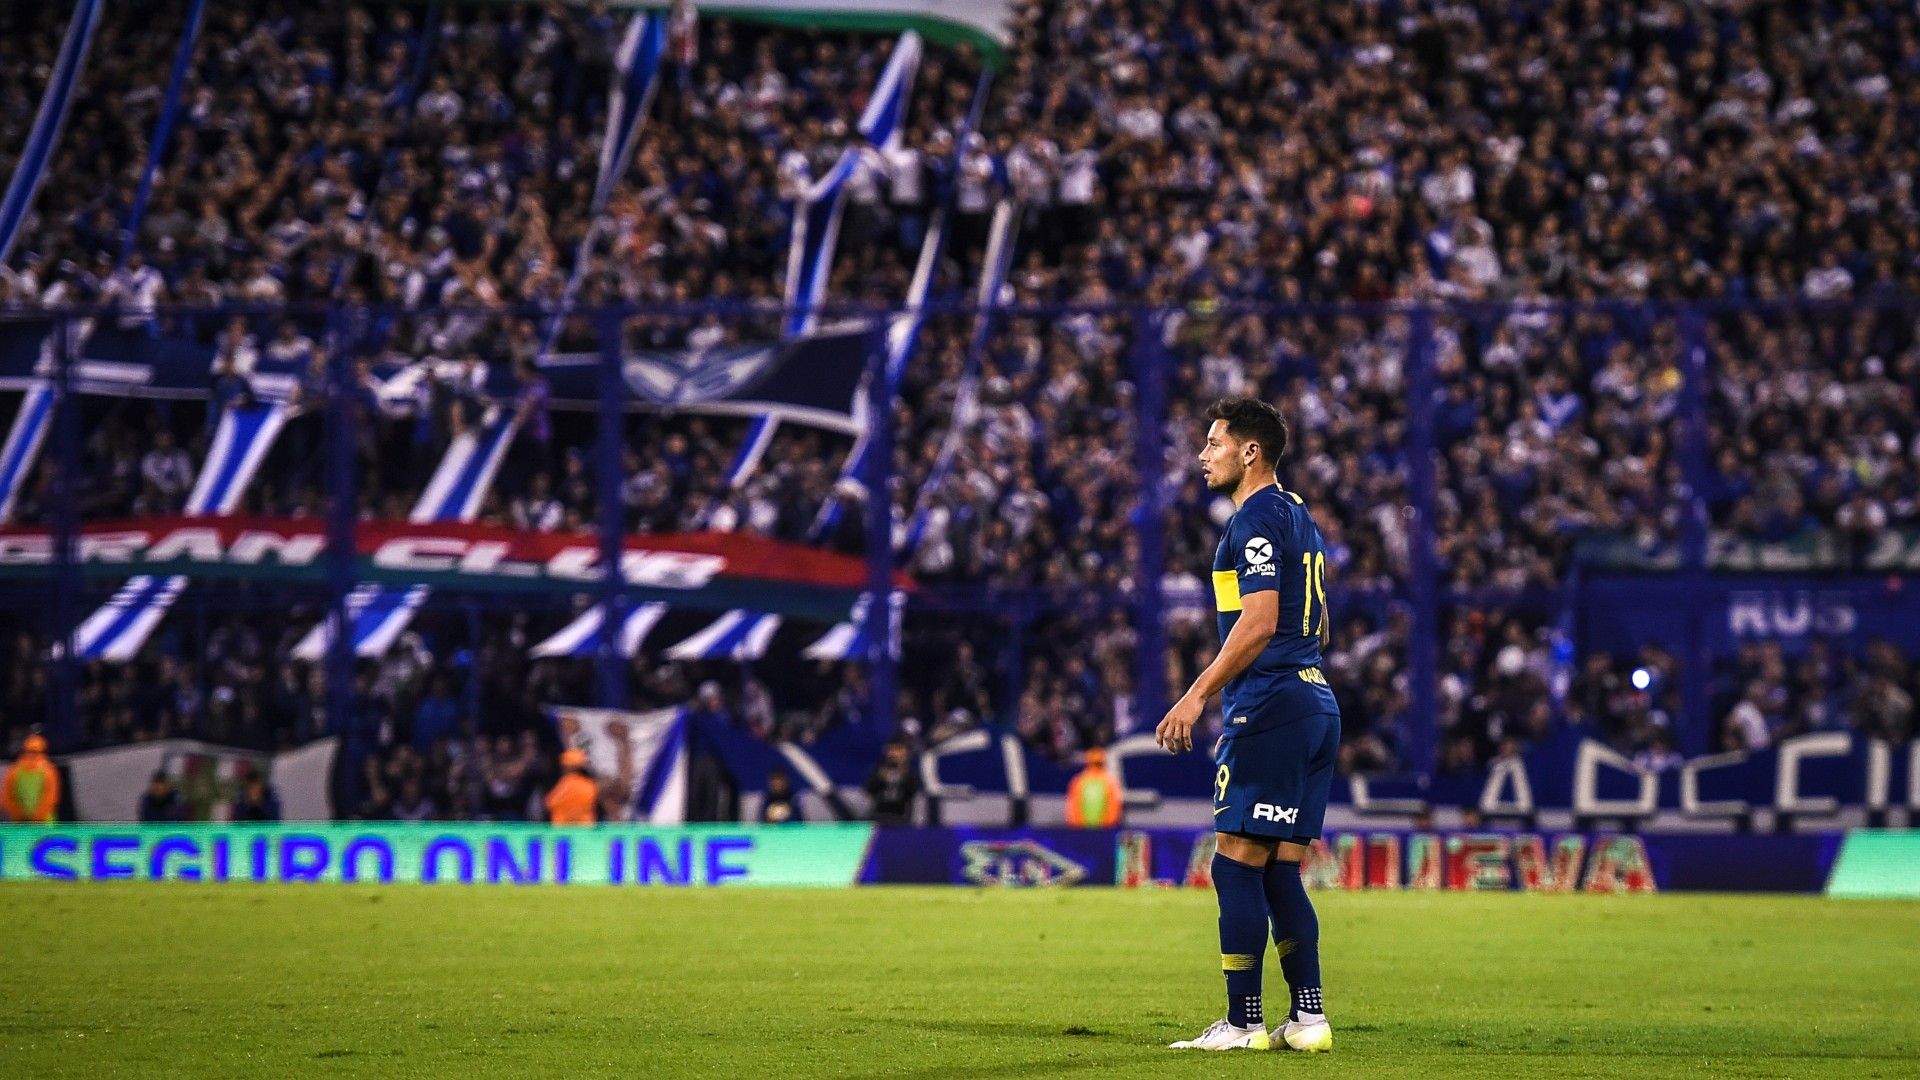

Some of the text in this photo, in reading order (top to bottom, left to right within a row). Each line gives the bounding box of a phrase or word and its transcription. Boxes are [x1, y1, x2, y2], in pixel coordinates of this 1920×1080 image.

[1245, 563, 1276, 577] AXION
[30, 833, 754, 885] SEGURO ONLINE
